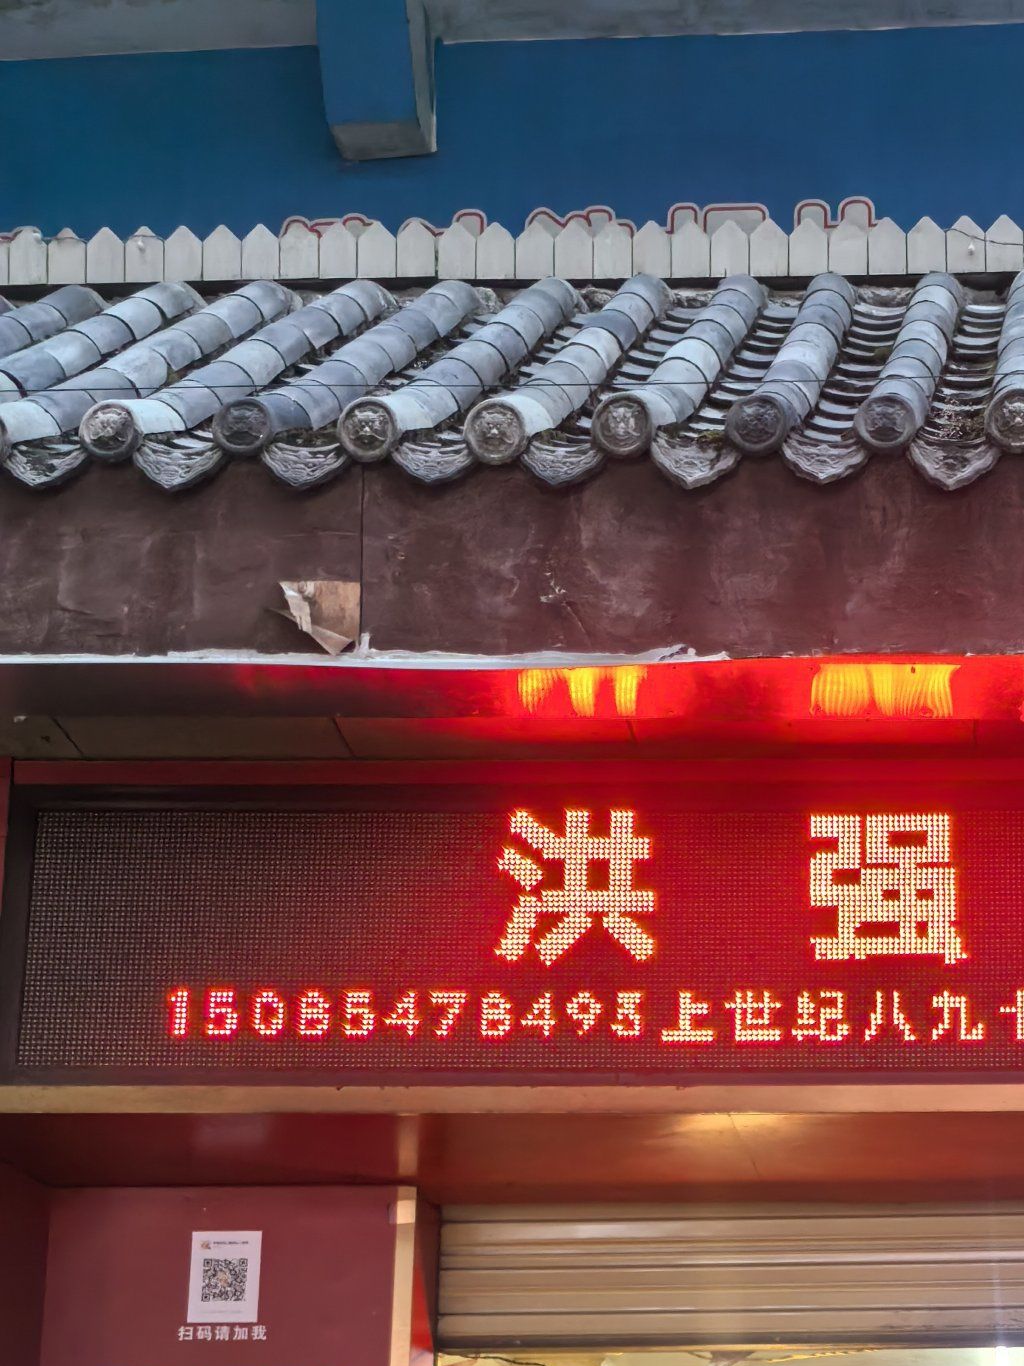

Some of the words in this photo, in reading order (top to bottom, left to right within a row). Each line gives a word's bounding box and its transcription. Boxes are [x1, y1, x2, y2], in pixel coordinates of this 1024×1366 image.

[178, 1325, 268, 1341] 扫码请加我
